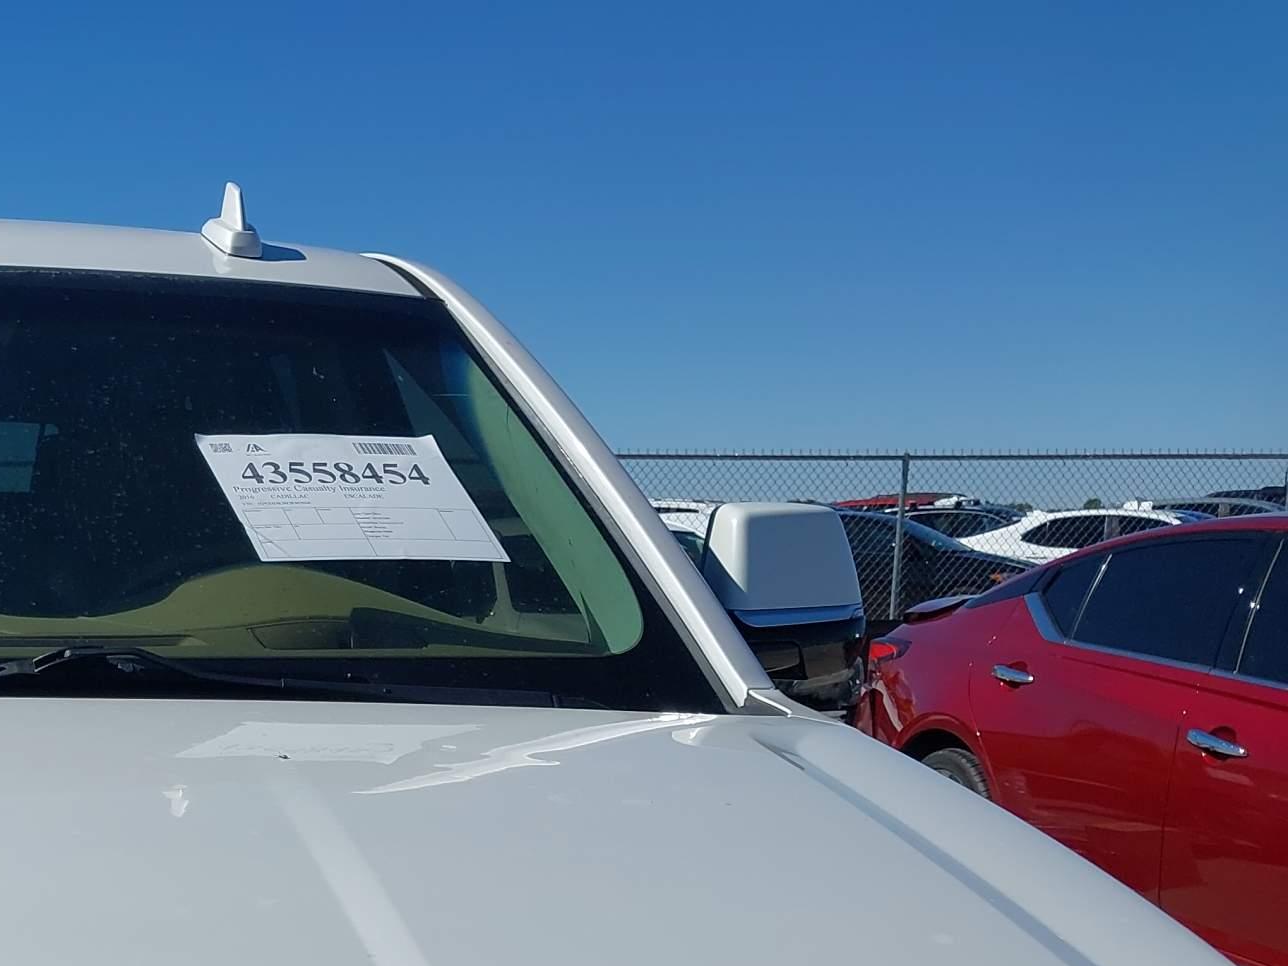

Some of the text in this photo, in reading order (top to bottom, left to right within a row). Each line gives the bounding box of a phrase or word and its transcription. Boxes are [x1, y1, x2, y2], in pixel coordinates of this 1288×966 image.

[241, 461, 431, 485] 43558454
[232, 485, 386, 494] Progressive Casualty Insurance
